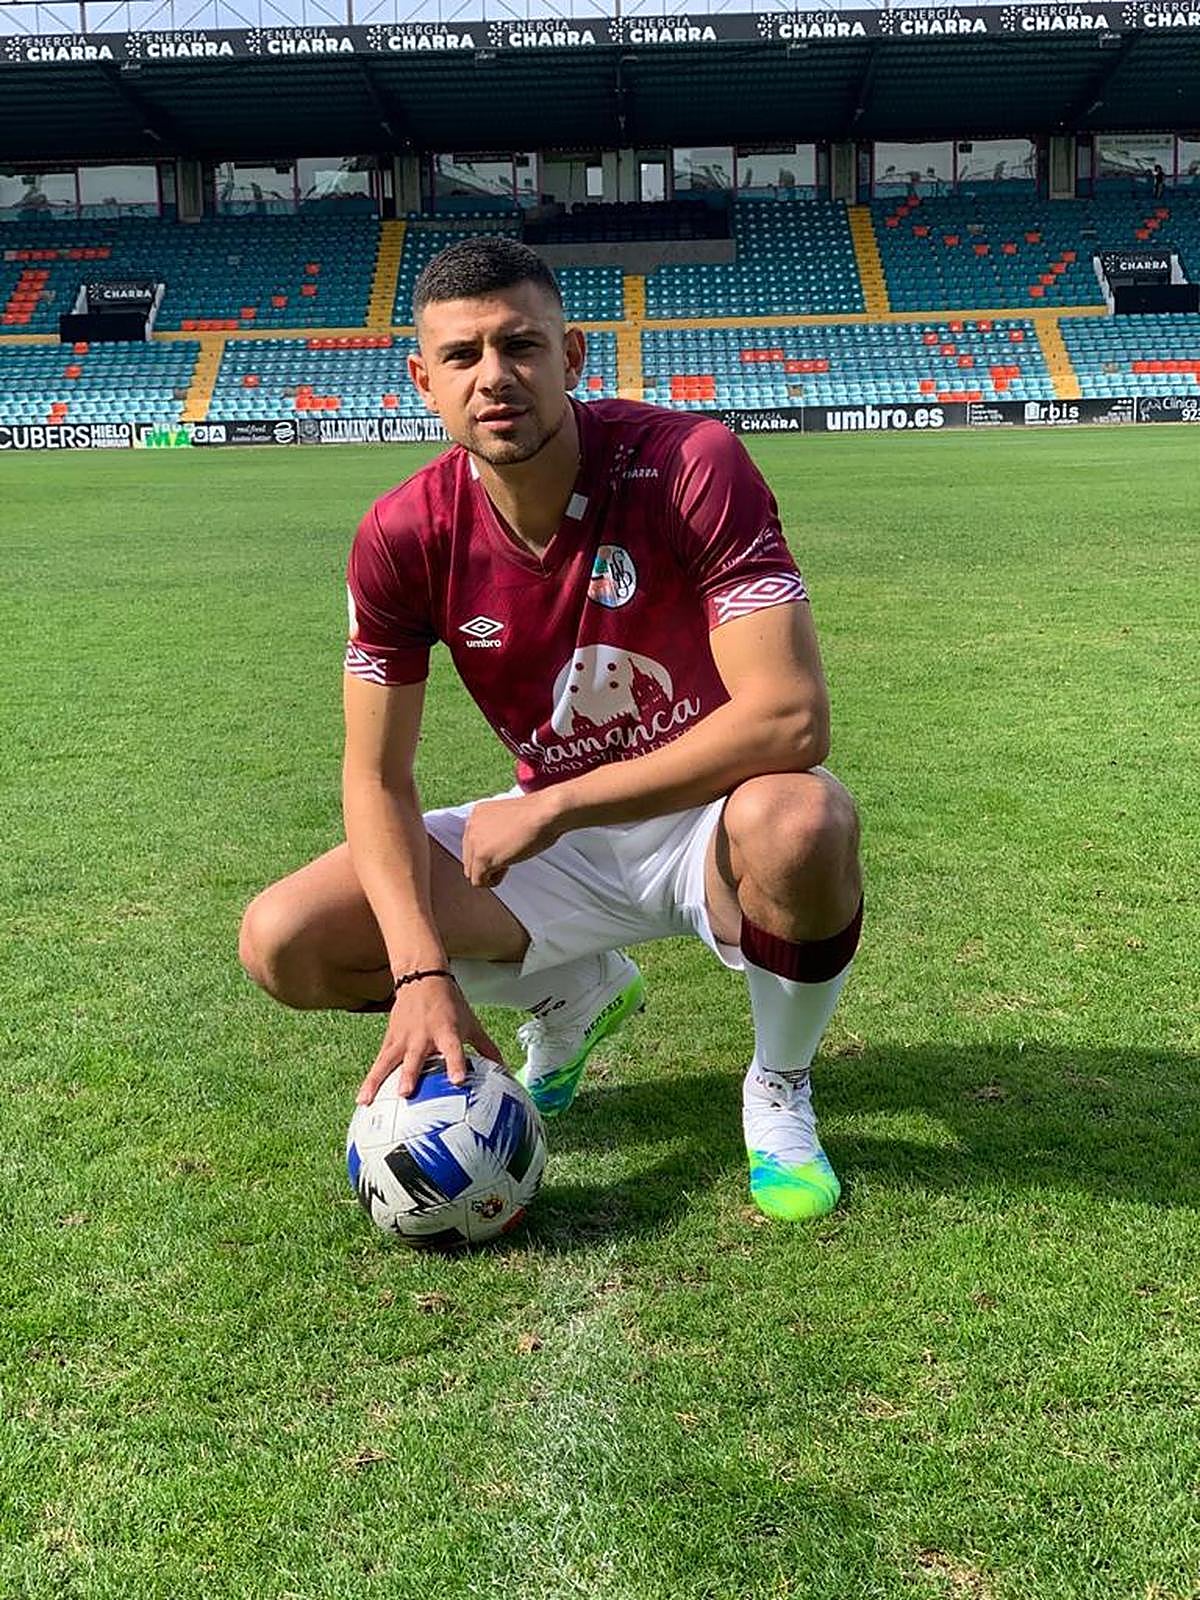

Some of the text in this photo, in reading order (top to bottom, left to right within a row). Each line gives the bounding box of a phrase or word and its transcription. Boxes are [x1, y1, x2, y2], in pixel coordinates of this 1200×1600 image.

[778, 22, 866, 38] CHARRA
[900, 18, 988, 35] CHARRA
[1021, 14, 1109, 31] CHARRA
[387, 34, 475, 50] CHARRA
[508, 30, 595, 47] CHARRA
[629, 26, 717, 43] CHARRA
[27, 46, 114, 62] CHARRA
[147, 41, 234, 58] CHARRA
[267, 38, 354, 54] CHARRA
[1119, 260, 1168, 271] CHARRA
[103, 288, 152, 299] CHARRA
[741, 418, 799, 430] CHARRA
[826, 404, 945, 431] umbro.es
[0, 426, 90, 449] CUBERS
[91, 424, 130, 439] HIELO
[319, 418, 380, 443] SALAMANCA
[381, 418, 423, 442] CLASSIC
[465, 638, 503, 649] umbro
